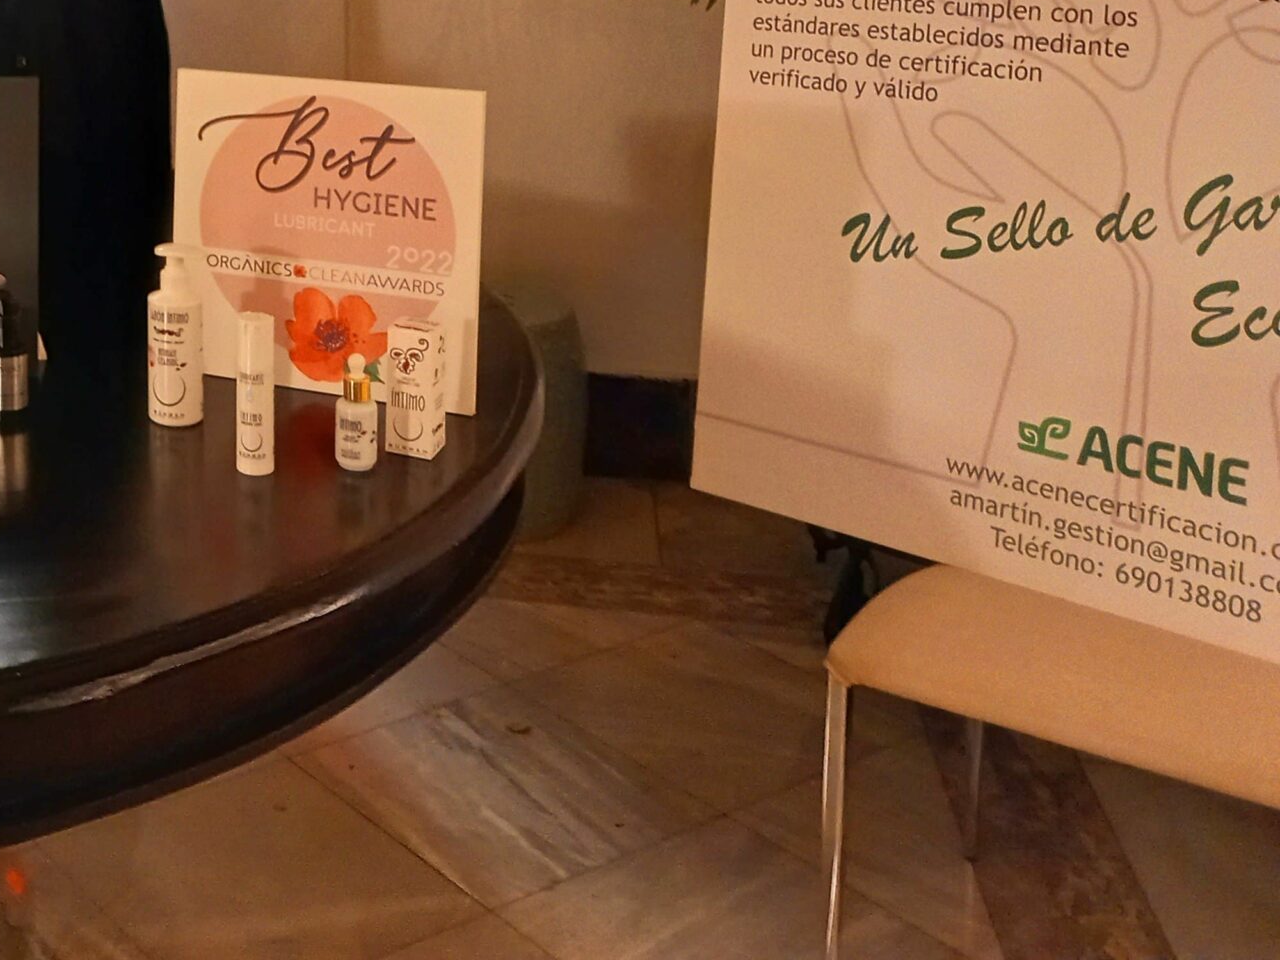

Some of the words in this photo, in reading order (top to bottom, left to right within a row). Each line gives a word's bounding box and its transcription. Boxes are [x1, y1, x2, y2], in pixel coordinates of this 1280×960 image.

[1051, 5, 1093, 25] con
[1103, 4, 1138, 28] los
[753, 15, 860, 39] estándares
[867, 23, 1004, 50] establecidos
[1013, 33, 1130, 59] mediante
[751, 43, 773, 59] un
[781, 45, 858, 67] proceso
[865, 48, 892, 70] de
[899, 51, 1043, 82] certificación
[749, 66, 847, 94] verificado
[854, 80, 866, 100] y
[873, 77, 938, 102] válido
[198, 95, 416, 193] Best
[313, 187, 437, 221] HYGIENE
[273, 212, 376, 238] LUBRICANT
[841, 212, 919, 262] Un
[940, 199, 1074, 261] Sello
[1096, 192, 1159, 243] de
[385, 245, 453, 275] 2022
[1077, 426, 1249, 506] ACENE
[990, 526, 1104, 578] Teléfono:
[1115, 562, 1262, 623] 690138808
